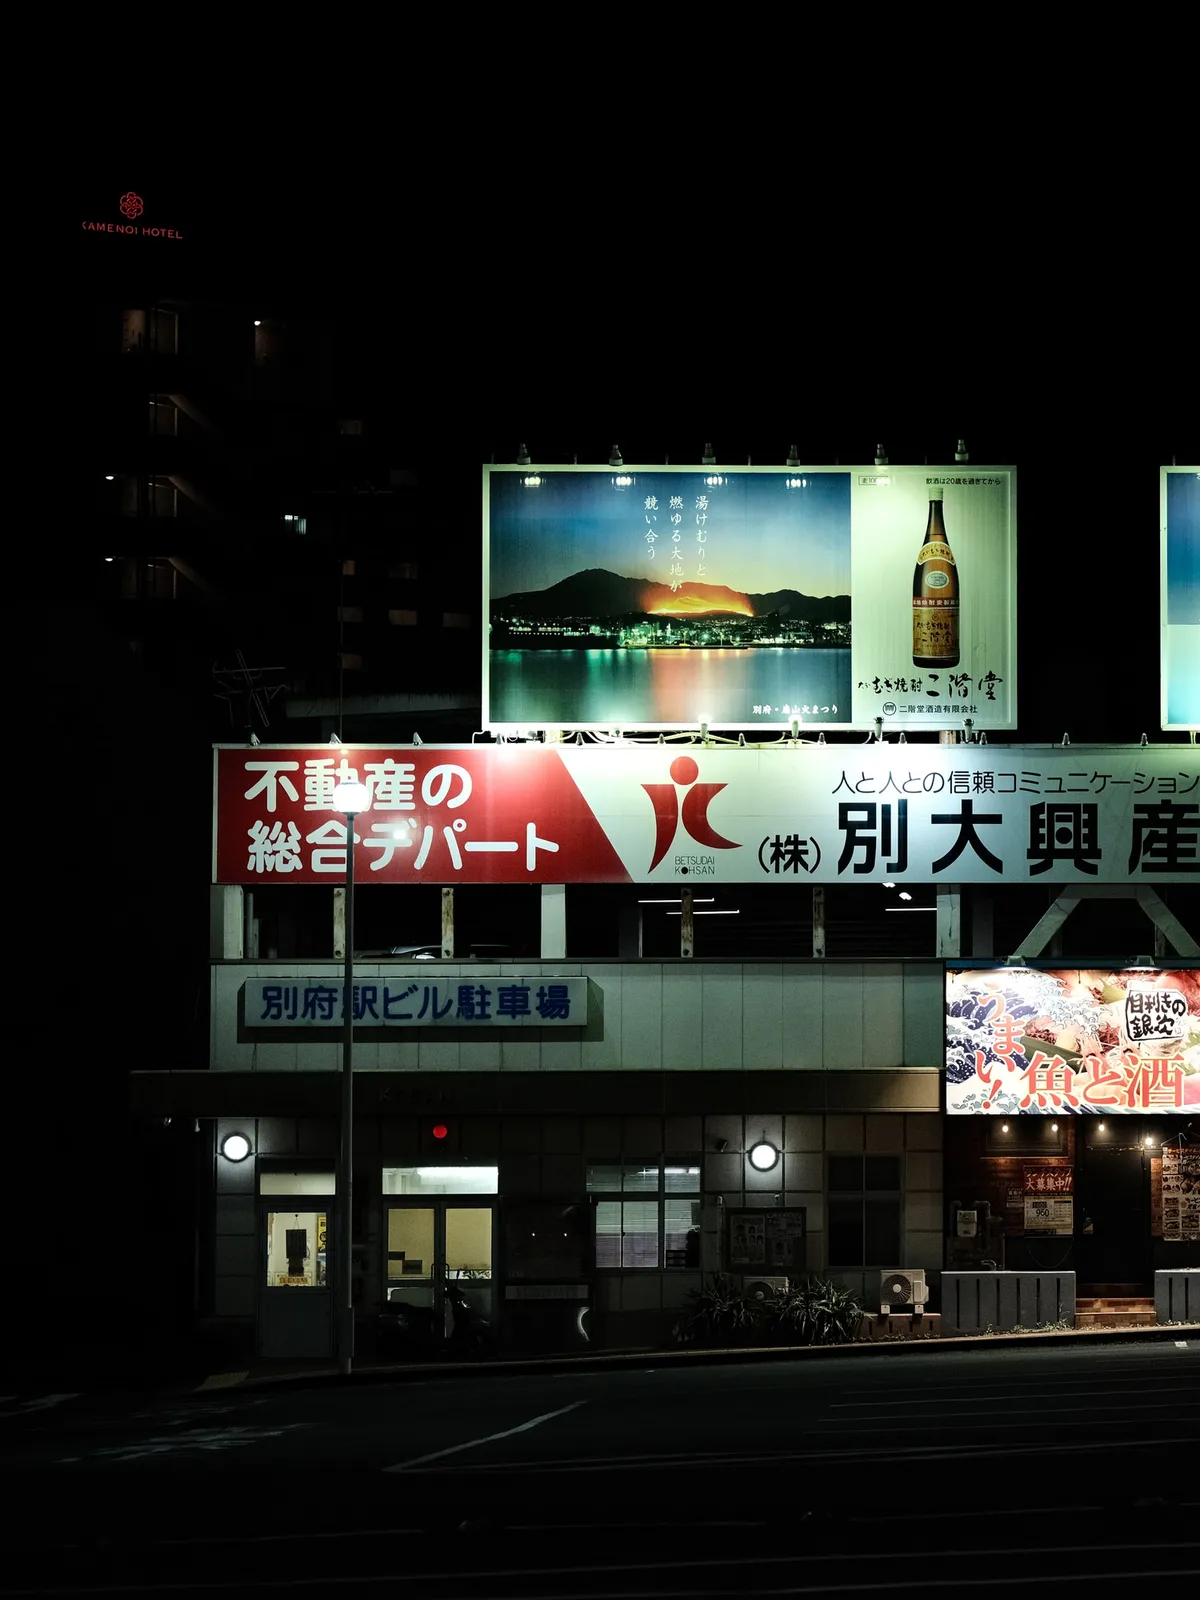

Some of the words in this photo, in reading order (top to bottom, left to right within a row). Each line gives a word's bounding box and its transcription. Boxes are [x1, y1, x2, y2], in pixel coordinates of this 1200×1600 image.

[142, 227, 183, 239] HOTEL
[644, 495, 659, 561] 競い合う
[669, 495, 684, 594] 燃ゆる大地が
[695, 495, 709, 577] 湯けむりと
[899, 703, 979, 714] 二階堂酒造有限会社
[244, 758, 473, 813] 不動産の
[832, 770, 1200, 796] 人と人との信頼コミュニケーション
[247, 818, 560, 874] 総合デパート
[837, 798, 1200, 876] 別大興産
[674, 856, 715, 865] BETSUDAI
[260, 984, 572, 1021] 別府駅ビル駐車場
[1130, 992, 1186, 1017] 目利きの
[1130, 1013, 1175, 1038] 銀次
[1019, 1053, 1186, 1108] 魚と酒
